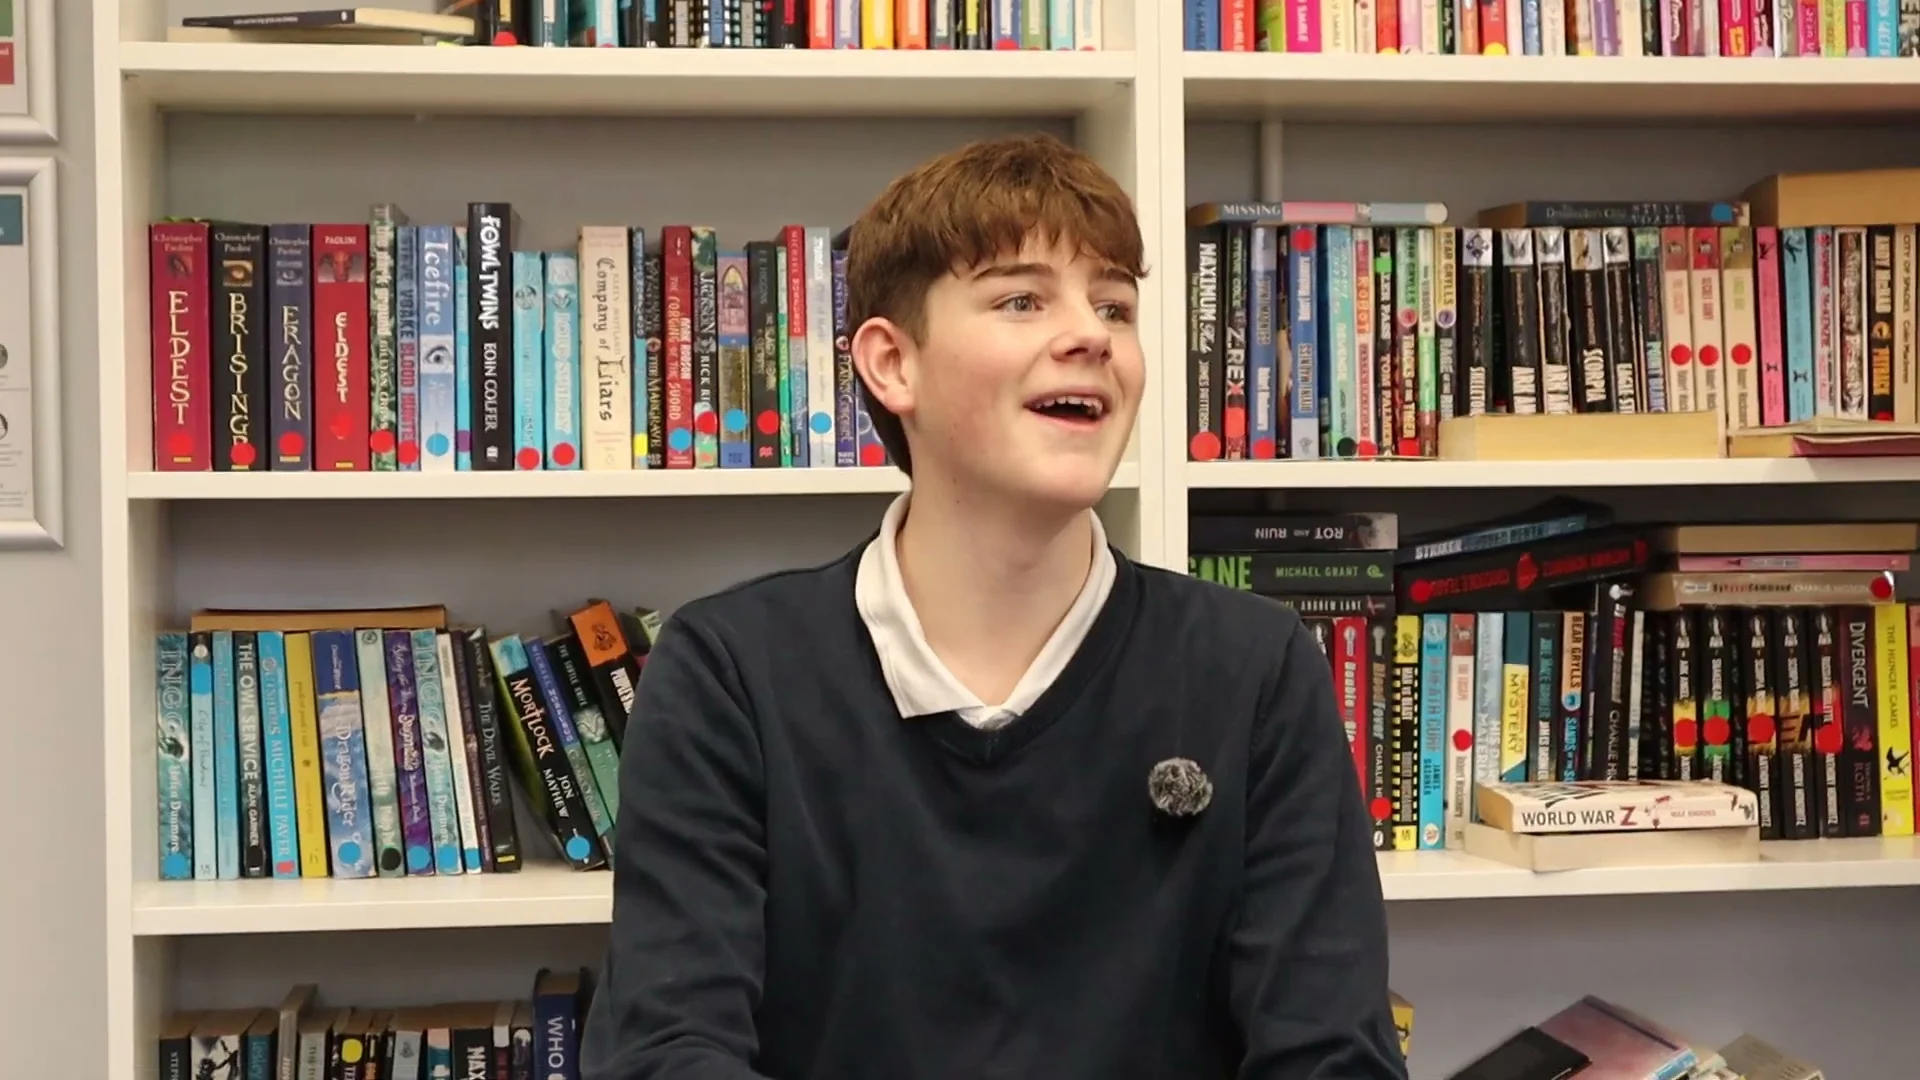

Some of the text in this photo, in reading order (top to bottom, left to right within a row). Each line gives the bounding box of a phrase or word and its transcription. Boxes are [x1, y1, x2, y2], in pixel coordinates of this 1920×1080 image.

[1223, 203, 1282, 215] MISSING
[324, 235, 357, 245] PAOLINI
[423, 240, 450, 327] Icefire
[478, 215, 501, 330] FOWL TWINS
[1199, 242, 1218, 321] MAXIMUM
[1443, 231, 1454, 307] BEAR GRYLLS
[1902, 235, 1912, 314] CITY OF SPADES
[400, 289, 418, 338] VOAKE
[592, 257, 626, 422] Company of Liars
[1378, 303, 1392, 340] PASS
[168, 291, 191, 425] ELDEST
[281, 306, 303, 421] ERAGON
[334, 312, 350, 404] ELDEST
[400, 343, 417, 389] BLOOD
[699, 355, 711, 385] RICK
[1402, 335, 1416, 379] TRACKS
[1440, 338, 1453, 374] RAGE
[1583, 348, 1607, 402] SCORPIA
[483, 342, 498, 433] EOIN COLFER
[669, 382, 682, 421] SWORD
[1198, 360, 1210, 432] JAMES PATTERSON
[1380, 353, 1393, 447] TOM PALMER
[1254, 527, 1288, 539] RUIN
[1315, 526, 1344, 539] ROT
[1275, 565, 1359, 578] MICHAEL GRANT
[1570, 615, 1585, 689] BEAR GRYLLS
[1848, 621, 1870, 709] DIVERGENT
[1885, 625, 1902, 730] THE HUNGER GAMES
[1679, 659, 1691, 699] ARK ANGEL
[238, 643, 259, 780] THE OWL SERVICE
[510, 676, 555, 760] MORTLOCK
[1489, 720, 1501, 748] HIS
[1508, 672, 1520, 754] MYSTERY
[1538, 720, 1551, 746] JAMES
[1563, 717, 1578, 752] SANDS
[1607, 709, 1620, 760] CHARLIE
[331, 725, 358, 827] Dragon Rider
[477, 702, 504, 806] THE DEVIL WALKS
[1374, 743, 1385, 784] CHARLIE
[1432, 763, 1441, 791] JAMES
[1457, 755, 1470, 779] Robert
[271, 739, 291, 858] MICHELLE PAVER
[543, 767, 569, 819] MAYHEW
[557, 774, 575, 799] JON
[1758, 754, 1773, 828] ANTHONY HOROWITZ
[1792, 753, 1807, 827] ANTHONY HOROWITZ
[1825, 752, 1839, 825] ANTHONY HOROWITZ
[1853, 762, 1867, 803] ROTH
[168, 800, 183, 853] Dunmore
[248, 783, 260, 847] ALAN GARNER
[435, 793, 449, 846] Dunmore
[1521, 806, 1638, 827] WORLD WAR Z
[548, 1016, 565, 1069] WHO
